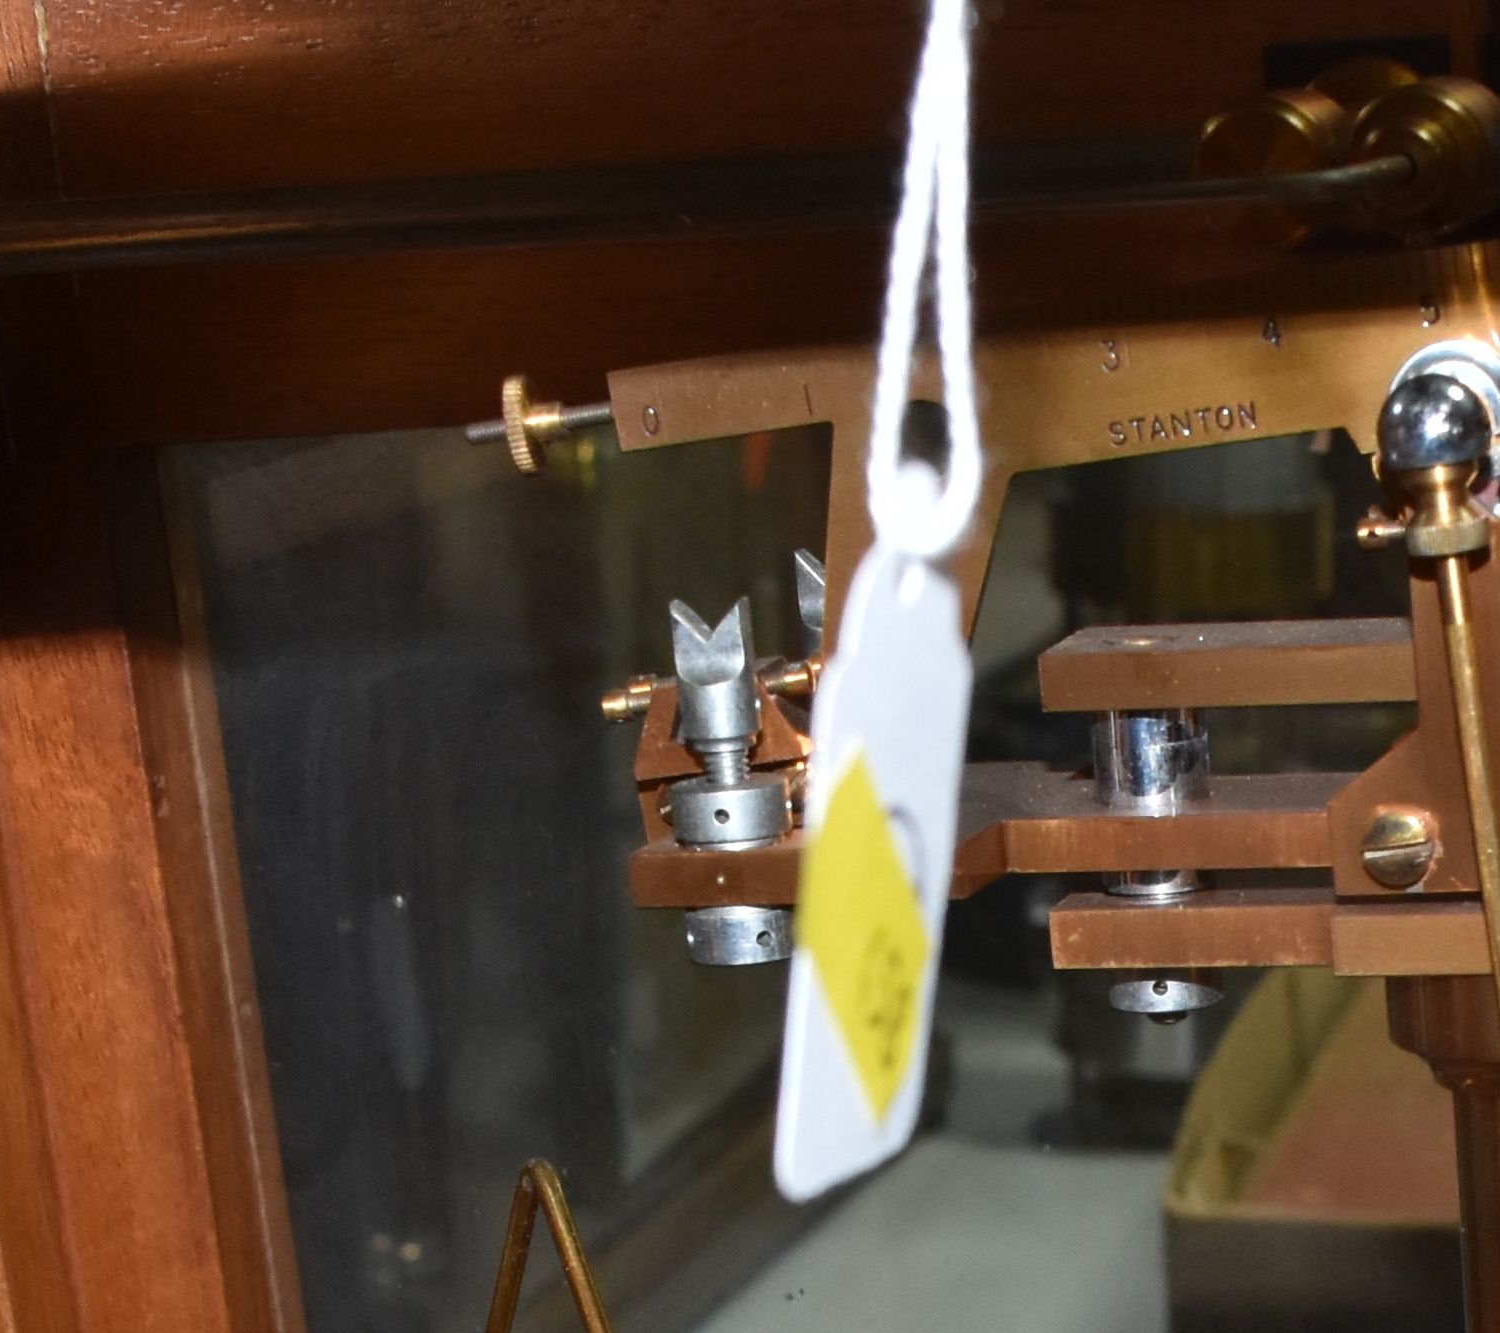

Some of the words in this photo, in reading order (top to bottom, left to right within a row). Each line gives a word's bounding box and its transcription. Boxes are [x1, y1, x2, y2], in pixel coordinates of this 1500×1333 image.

[642, 405, 662, 437] 0
[1101, 339, 1122, 373] 3
[1262, 316, 1284, 348] 4
[1108, 401, 1257, 447] STANTON
